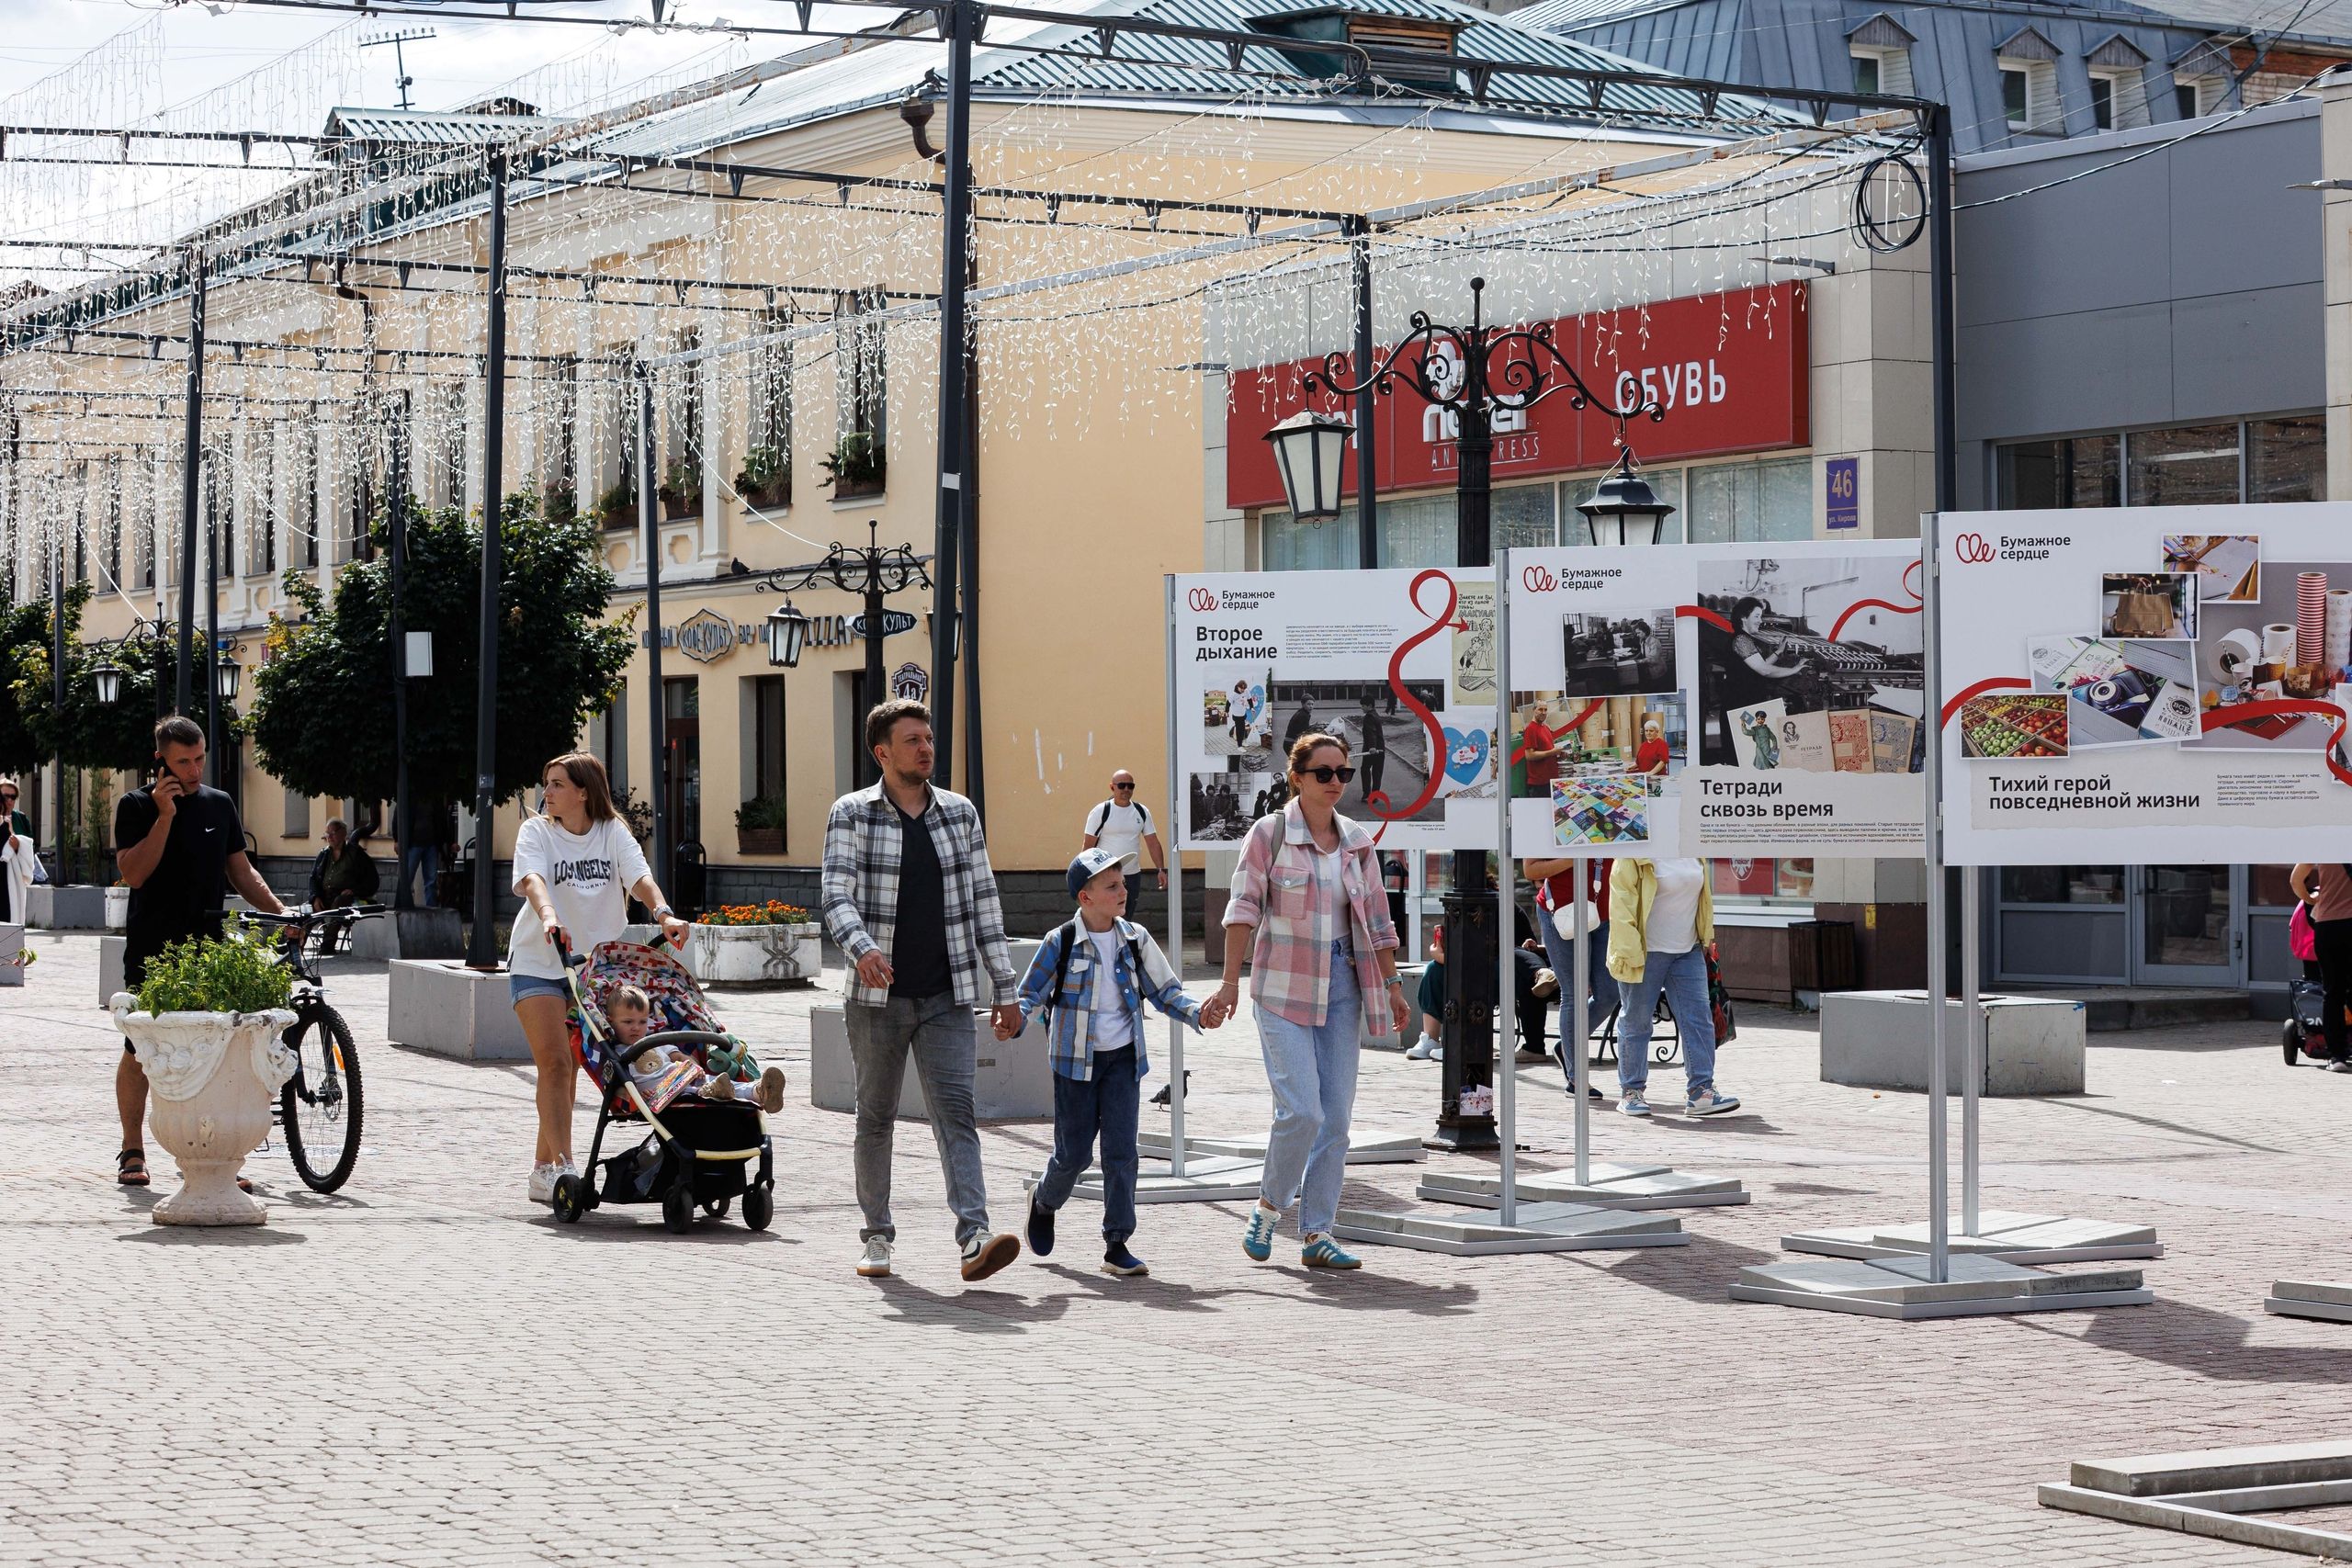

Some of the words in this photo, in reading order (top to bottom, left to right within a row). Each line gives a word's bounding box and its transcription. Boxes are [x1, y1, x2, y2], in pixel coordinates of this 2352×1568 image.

[1615, 359, 1725, 413] ОБУВЬ
[1832, 469, 1852, 498] 46
[2000, 536, 2071, 549] Бумажное
[2000, 548, 2050, 561] сердце
[1561, 568, 1623, 581] Бумажное
[1561, 579, 1604, 591] сердце
[1222, 590, 1275, 602] Бумажное
[1222, 601, 1259, 610] сердце
[1196, 626, 1262, 644] Второе
[1196, 646, 1277, 661] дыхание
[1700, 779, 1782, 798] Тетради
[1989, 775, 2049, 792] Тихий
[2053, 774, 2111, 795] герой
[1989, 794, 2132, 811] повседневной
[2136, 795, 2199, 808] жизни
[1700, 804, 1767, 818] сквозь
[1774, 804, 1833, 820] время
